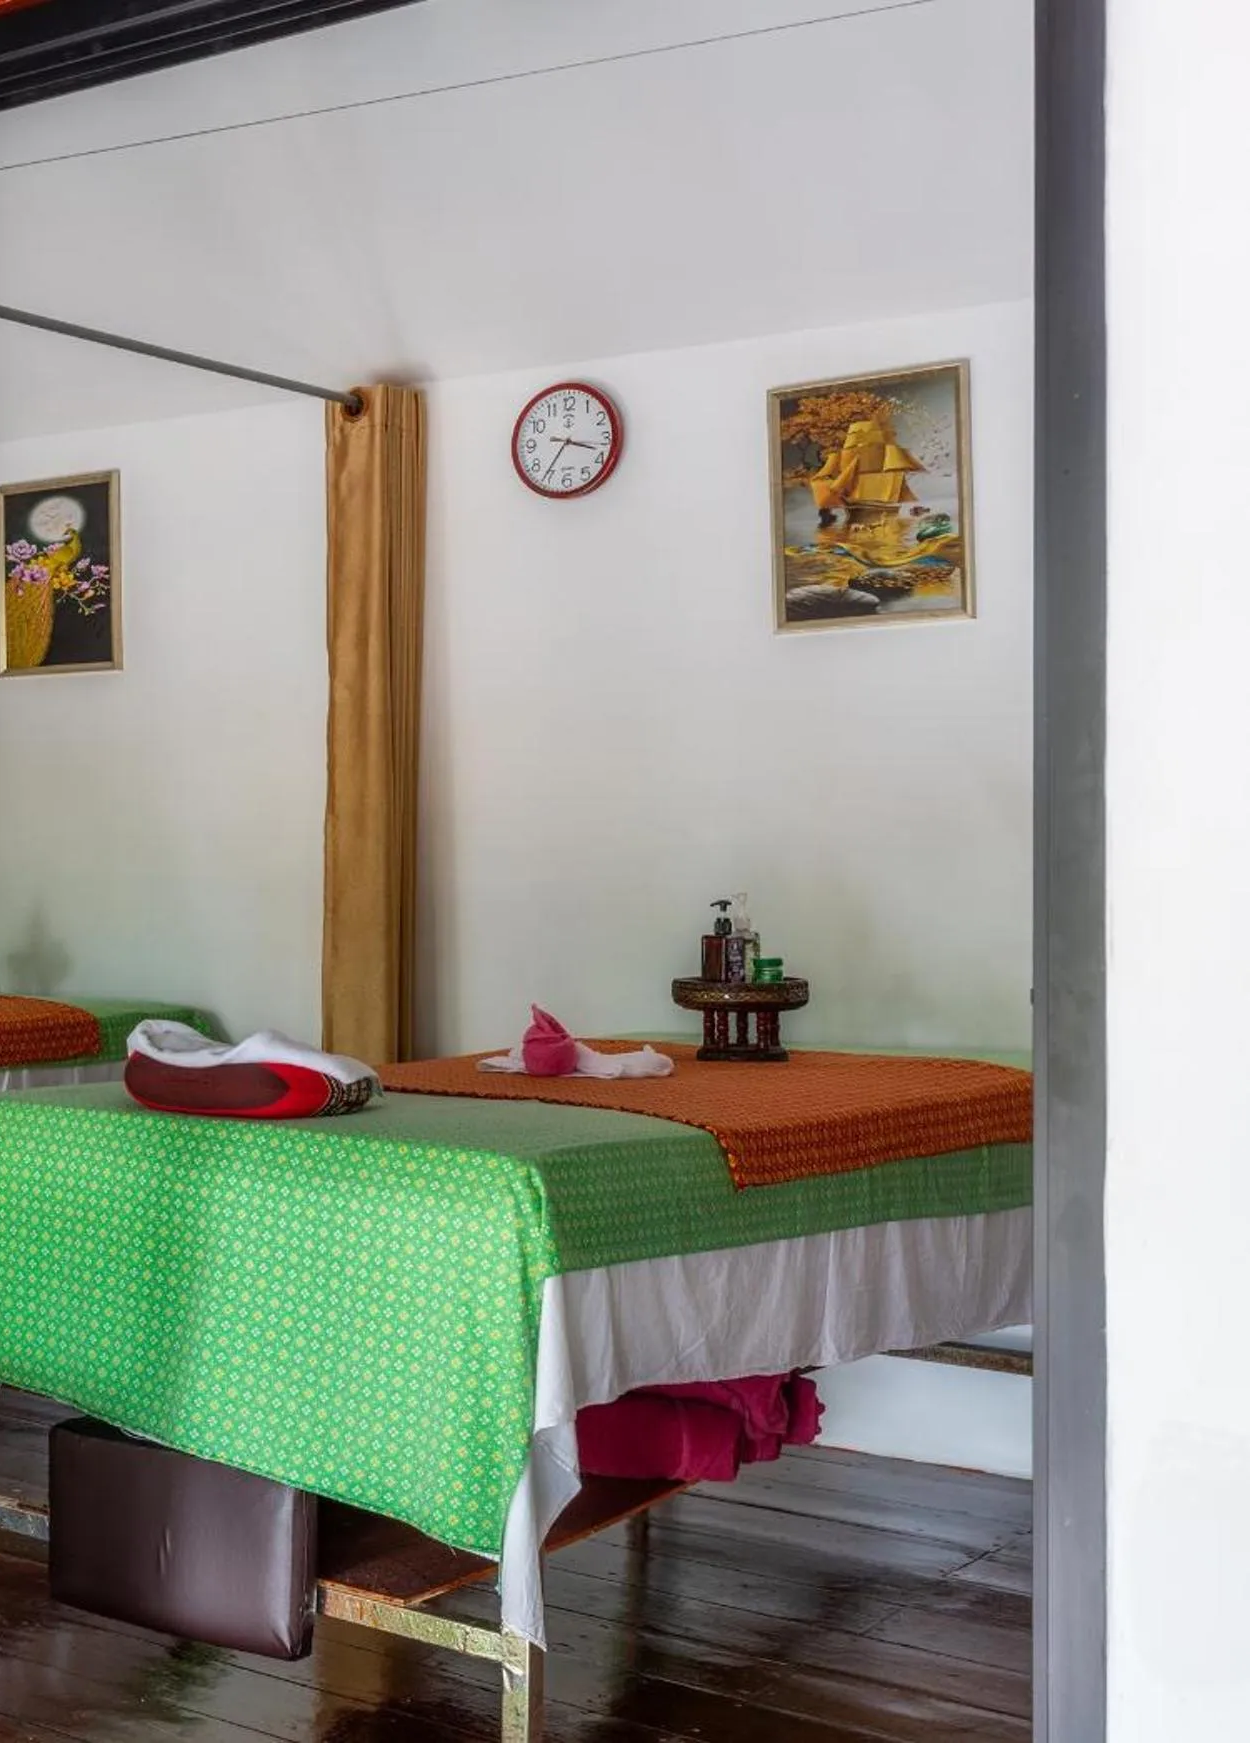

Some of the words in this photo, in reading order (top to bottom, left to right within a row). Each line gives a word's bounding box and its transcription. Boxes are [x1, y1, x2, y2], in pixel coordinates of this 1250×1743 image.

[547, 402, 557, 417] 11
[563, 396, 576, 411] 12
[585, 399, 590, 413] 1
[531, 419, 546, 433] 10
[596, 411, 606, 426] 2
[526, 438, 537, 453] 9
[600, 431, 610, 446] 3
[531, 458, 541, 472] 8
[594, 451, 605, 465] 4
[561, 472, 573, 488] 6
[580, 466, 591, 481] 5
